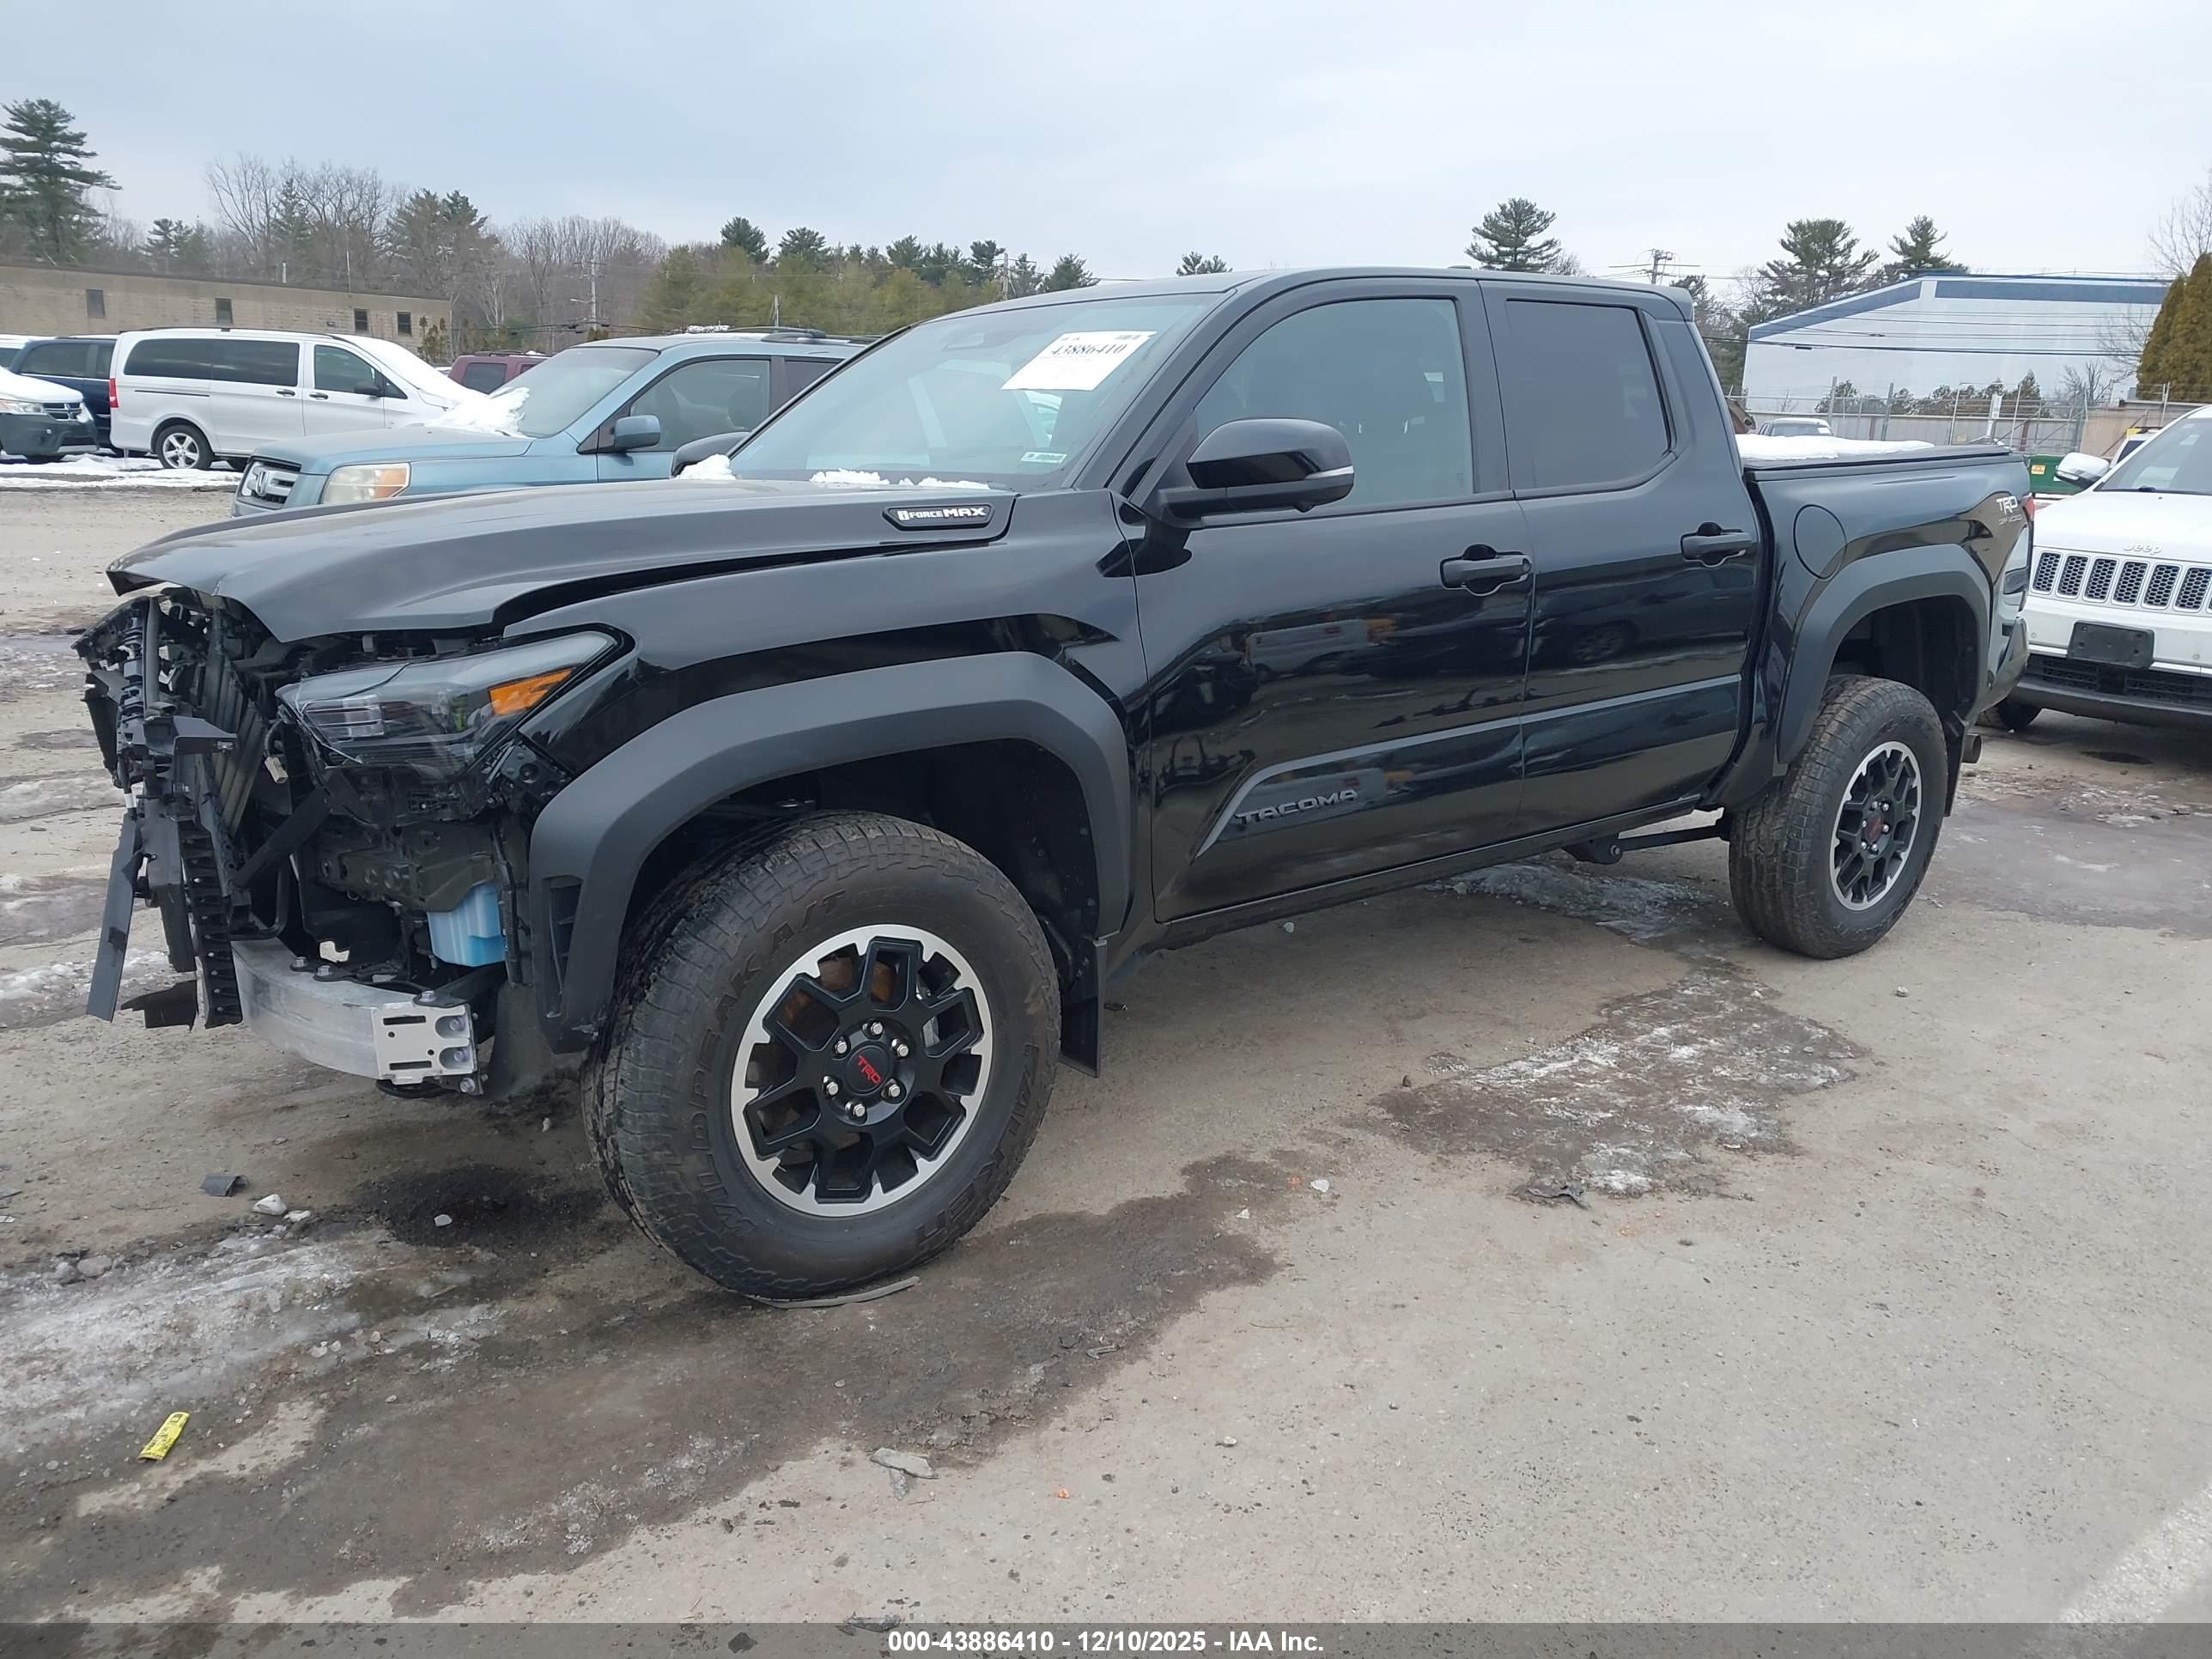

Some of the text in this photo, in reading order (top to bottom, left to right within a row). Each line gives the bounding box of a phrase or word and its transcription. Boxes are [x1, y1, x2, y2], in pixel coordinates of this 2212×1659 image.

[1996, 495, 2018, 514] TRD
[2124, 542, 2163, 555] Jeep
[1235, 789, 1358, 824] TACOMA
[857, 1054, 882, 1085] TRD
